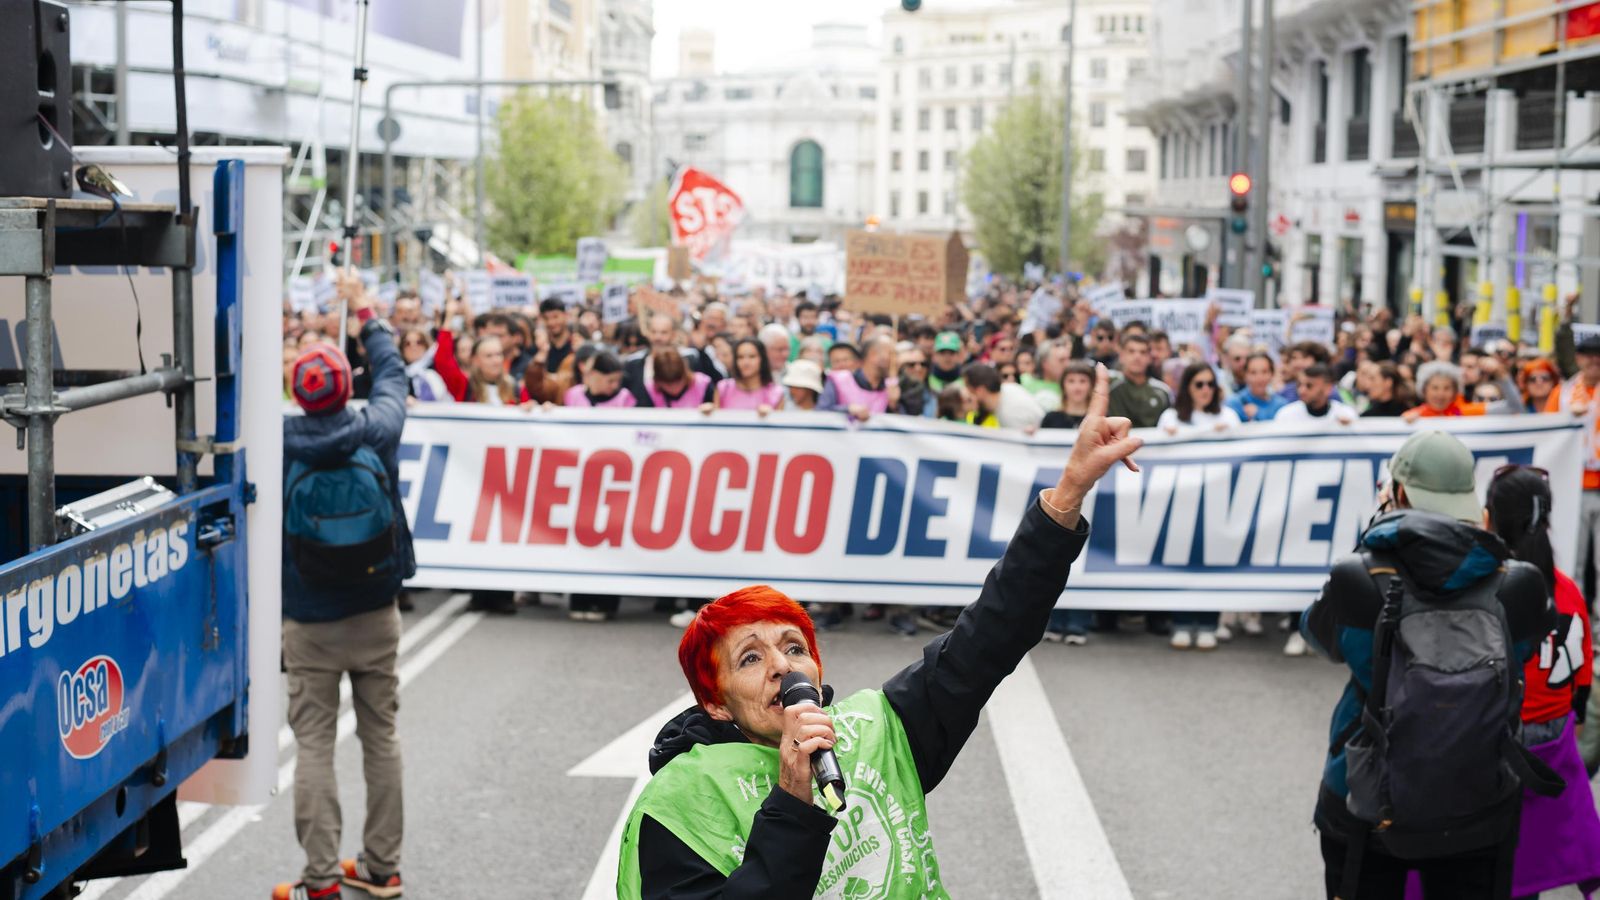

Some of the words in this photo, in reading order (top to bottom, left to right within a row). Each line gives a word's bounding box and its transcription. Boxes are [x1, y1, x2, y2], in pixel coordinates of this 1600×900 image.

[470, 446, 835, 555] NEGOCIO
[845, 456, 958, 559] DE
[0, 519, 188, 657] rgonetas
[58, 661, 109, 738] Ocsa
[815, 834, 881, 897] DESAHUCIOS
[885, 794, 907, 826] SIN
[896, 827, 916, 874] CASA
